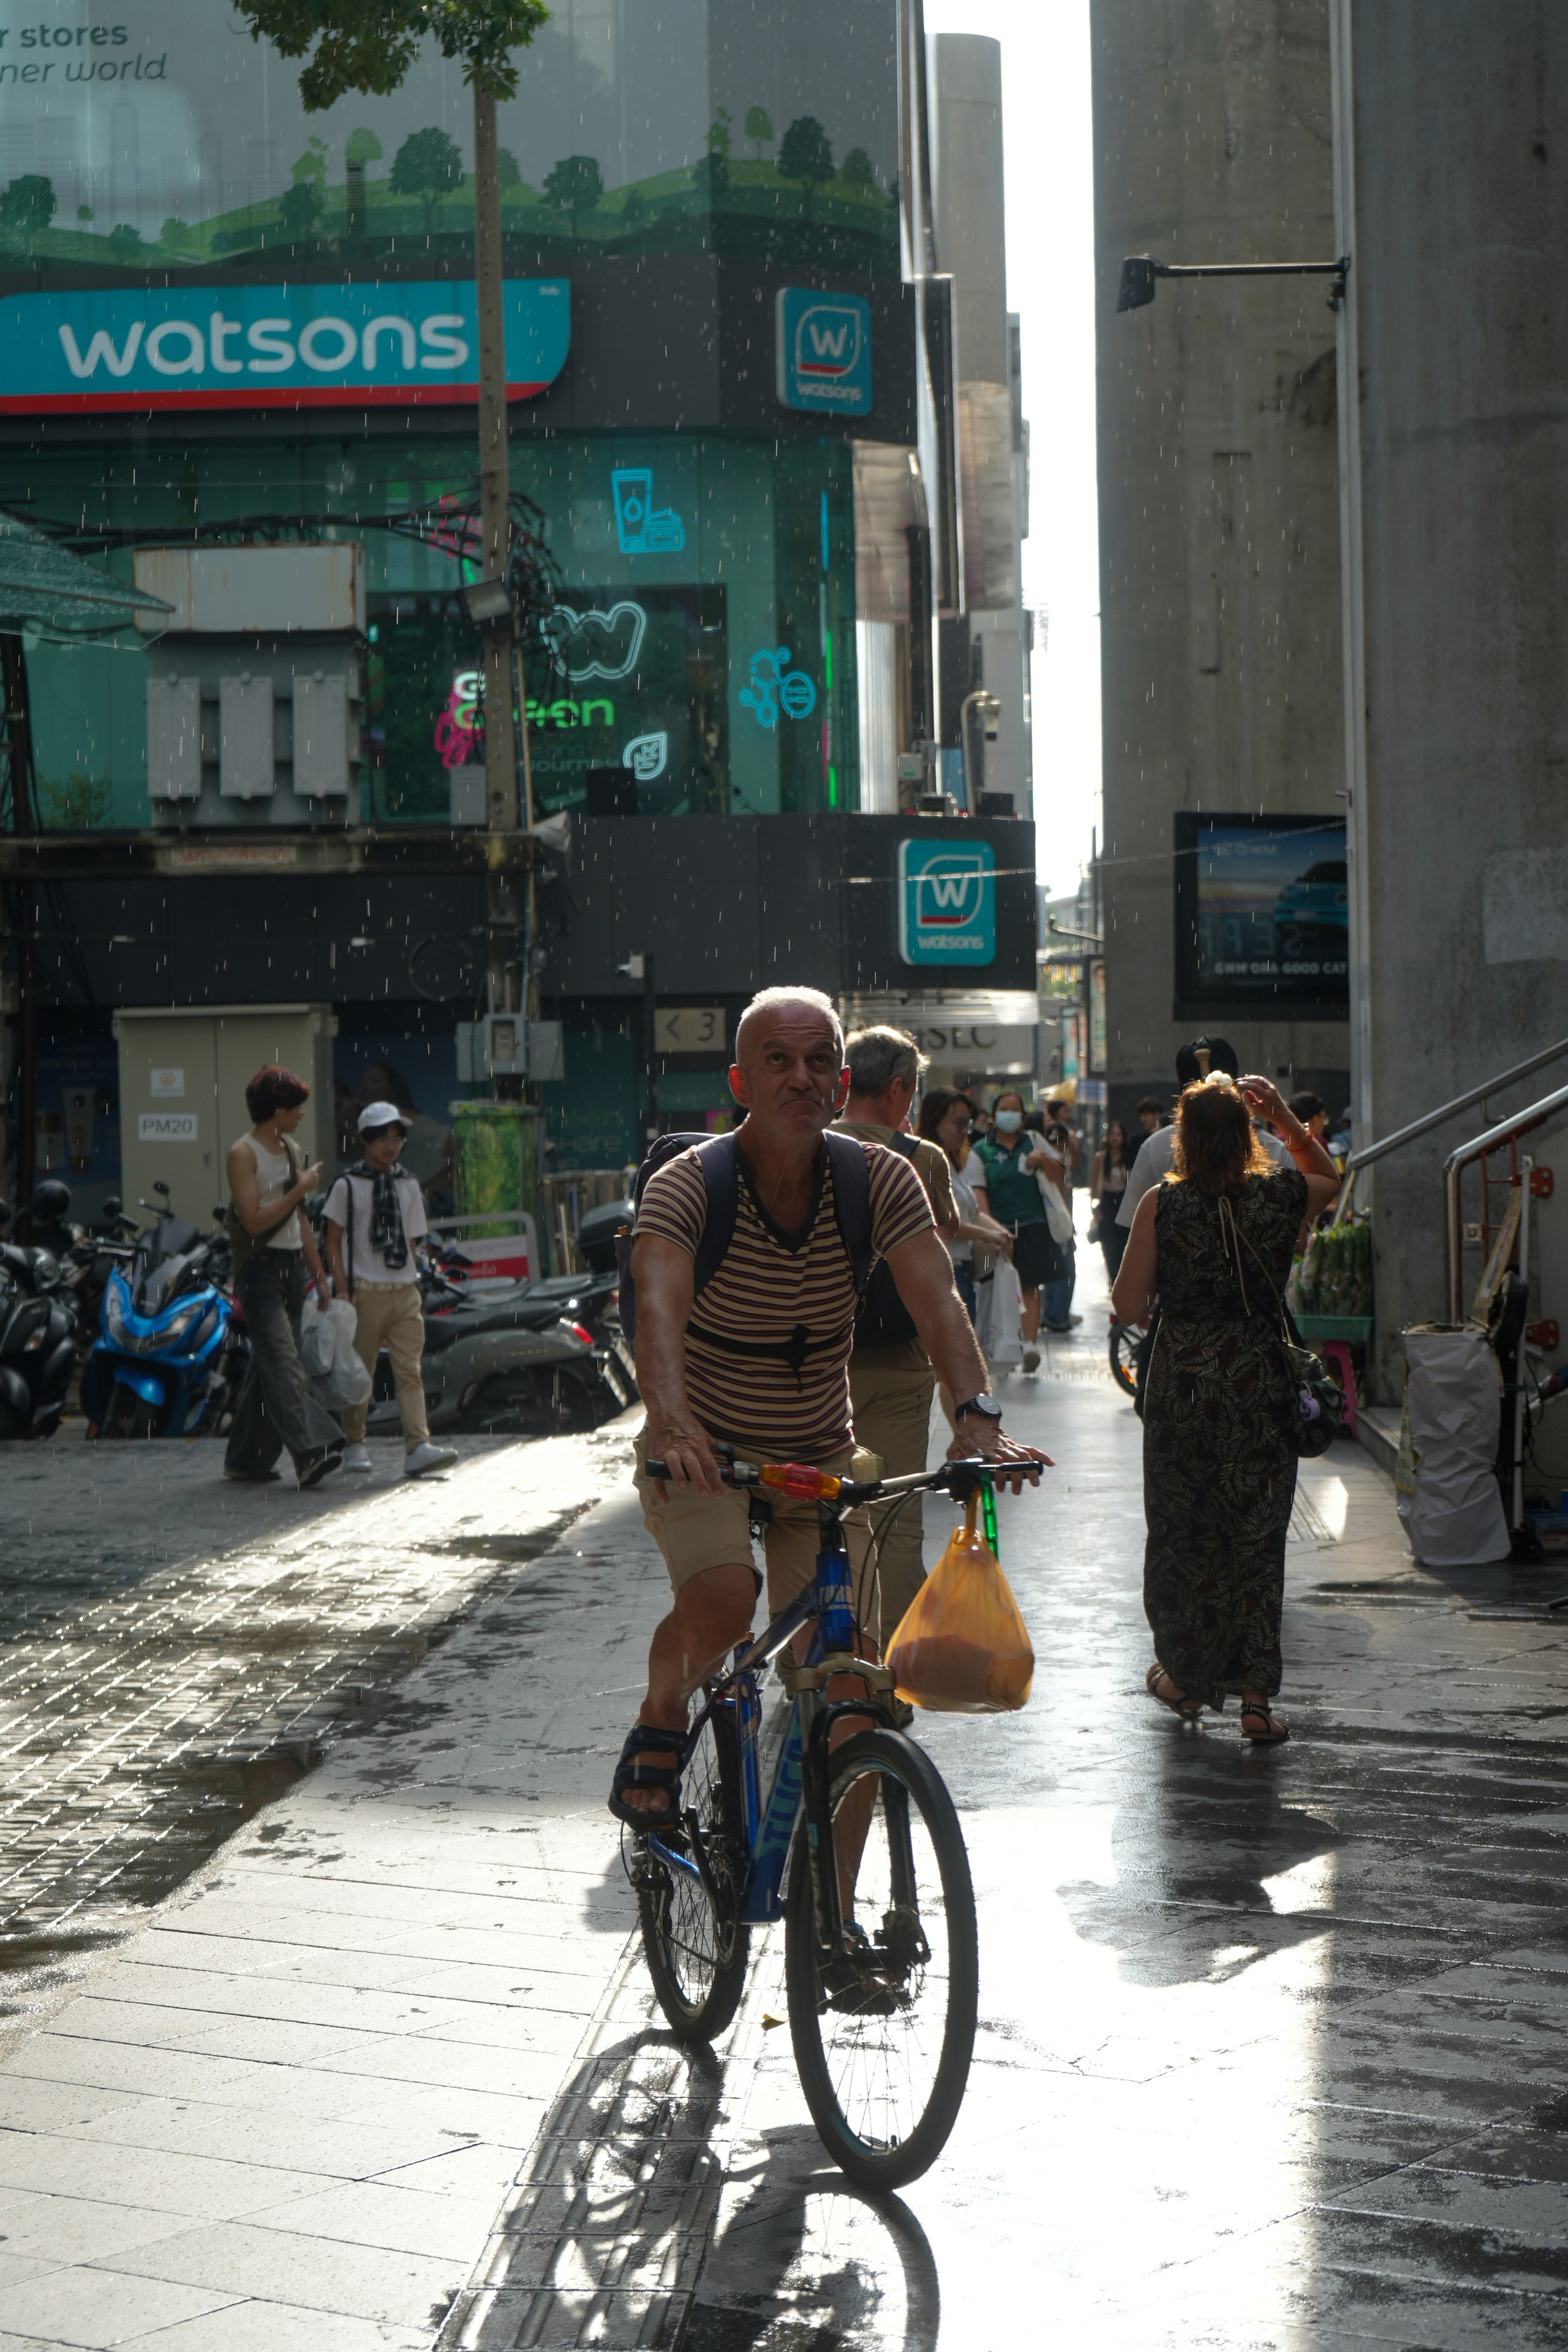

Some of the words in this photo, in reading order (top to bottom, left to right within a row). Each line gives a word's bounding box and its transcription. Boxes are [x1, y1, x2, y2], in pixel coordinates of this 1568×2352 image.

[21, 24, 128, 48] stores
[66, 53, 167, 81] world
[58, 312, 469, 378] watsons
[918, 934, 985, 950] watsons
[1281, 961, 1319, 974] GOOD
[1322, 961, 1347, 974] CAT
[698, 1012, 715, 1042] 3
[143, 1118, 192, 1134] PM20
